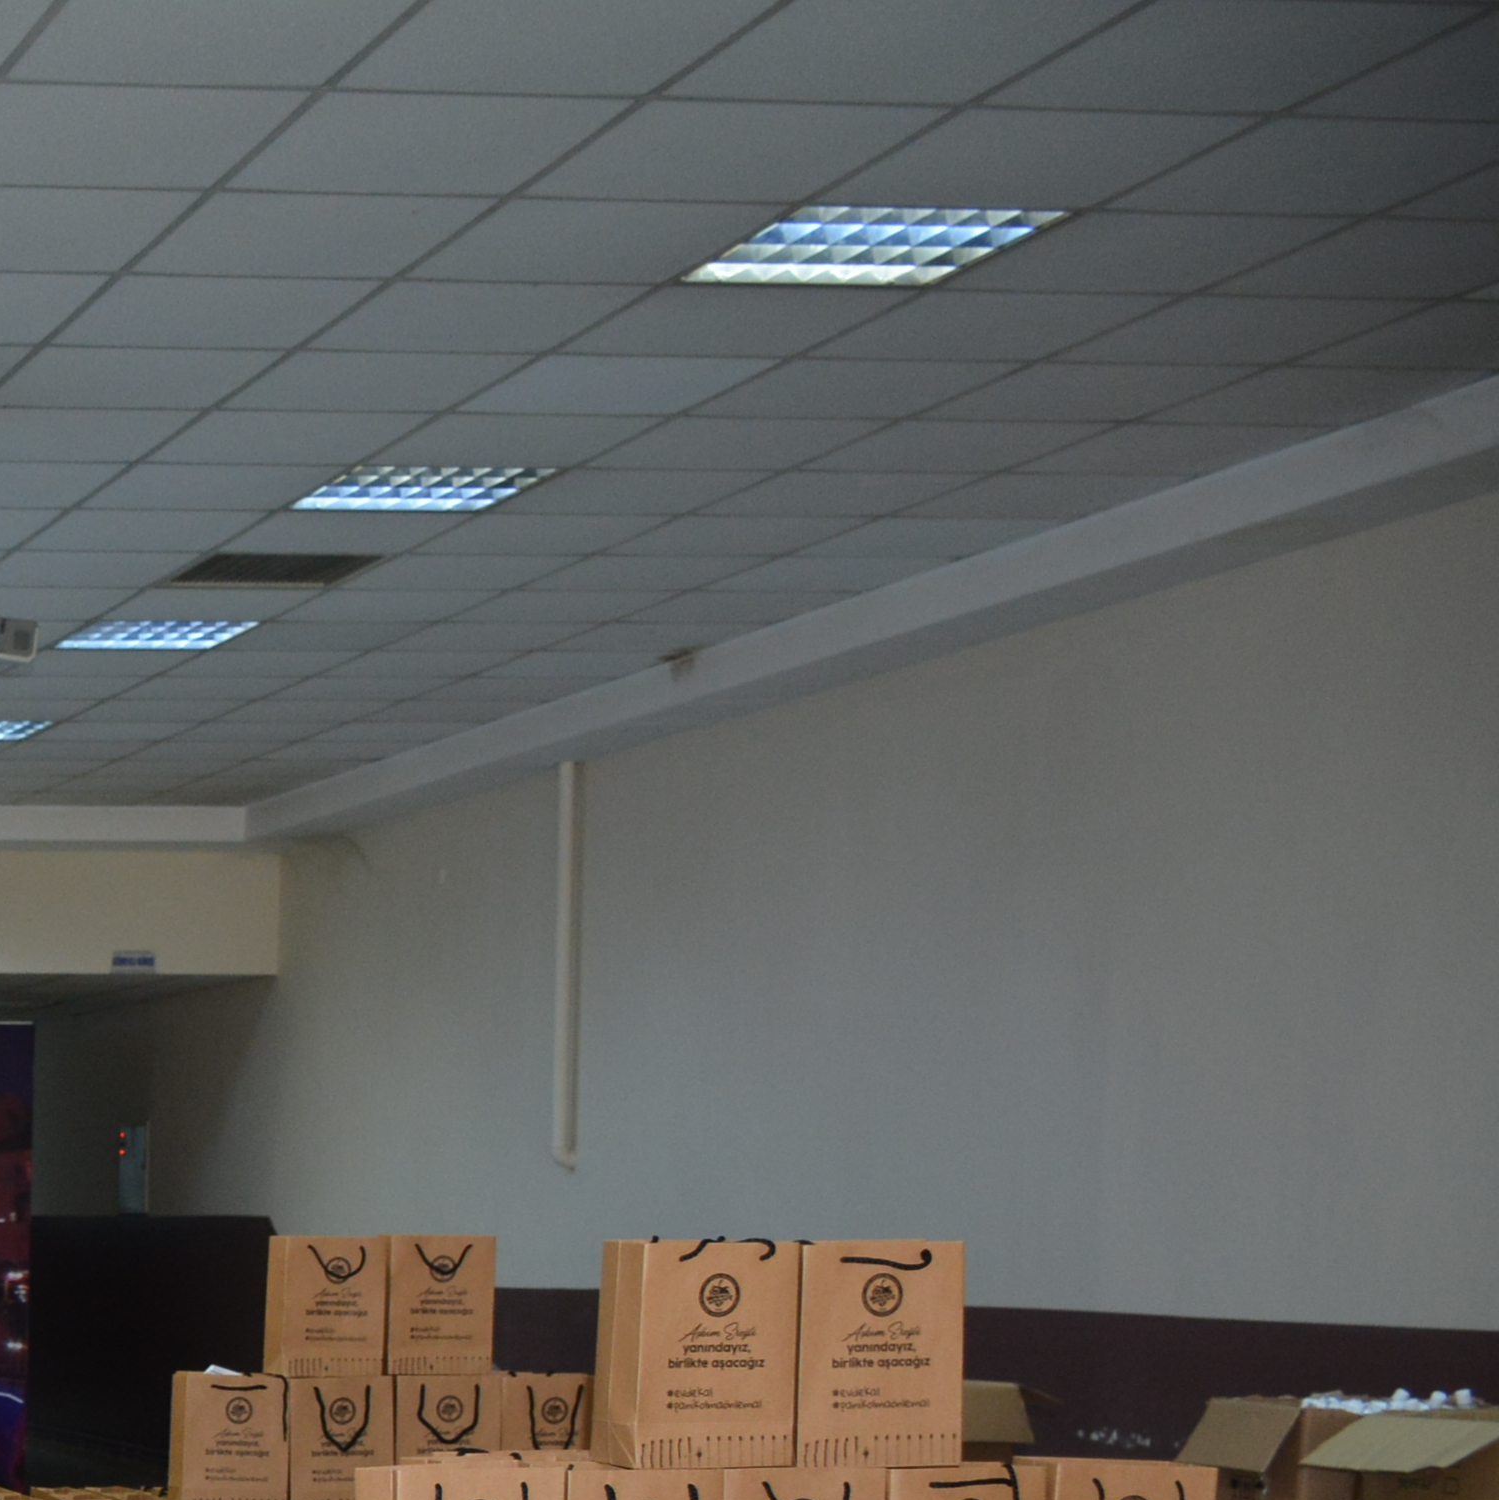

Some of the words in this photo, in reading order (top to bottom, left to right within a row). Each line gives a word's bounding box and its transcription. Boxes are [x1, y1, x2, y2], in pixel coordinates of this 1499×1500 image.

[682, 1342, 750, 1355] yanındayız,
[846, 1341, 915, 1354] yanındayız,
[667, 1357, 708, 1367] birlikte
[711, 1356, 764, 1370] aşacağız
[831, 1357, 873, 1367] birlikte
[876, 1355, 930, 1369] aşacağız
